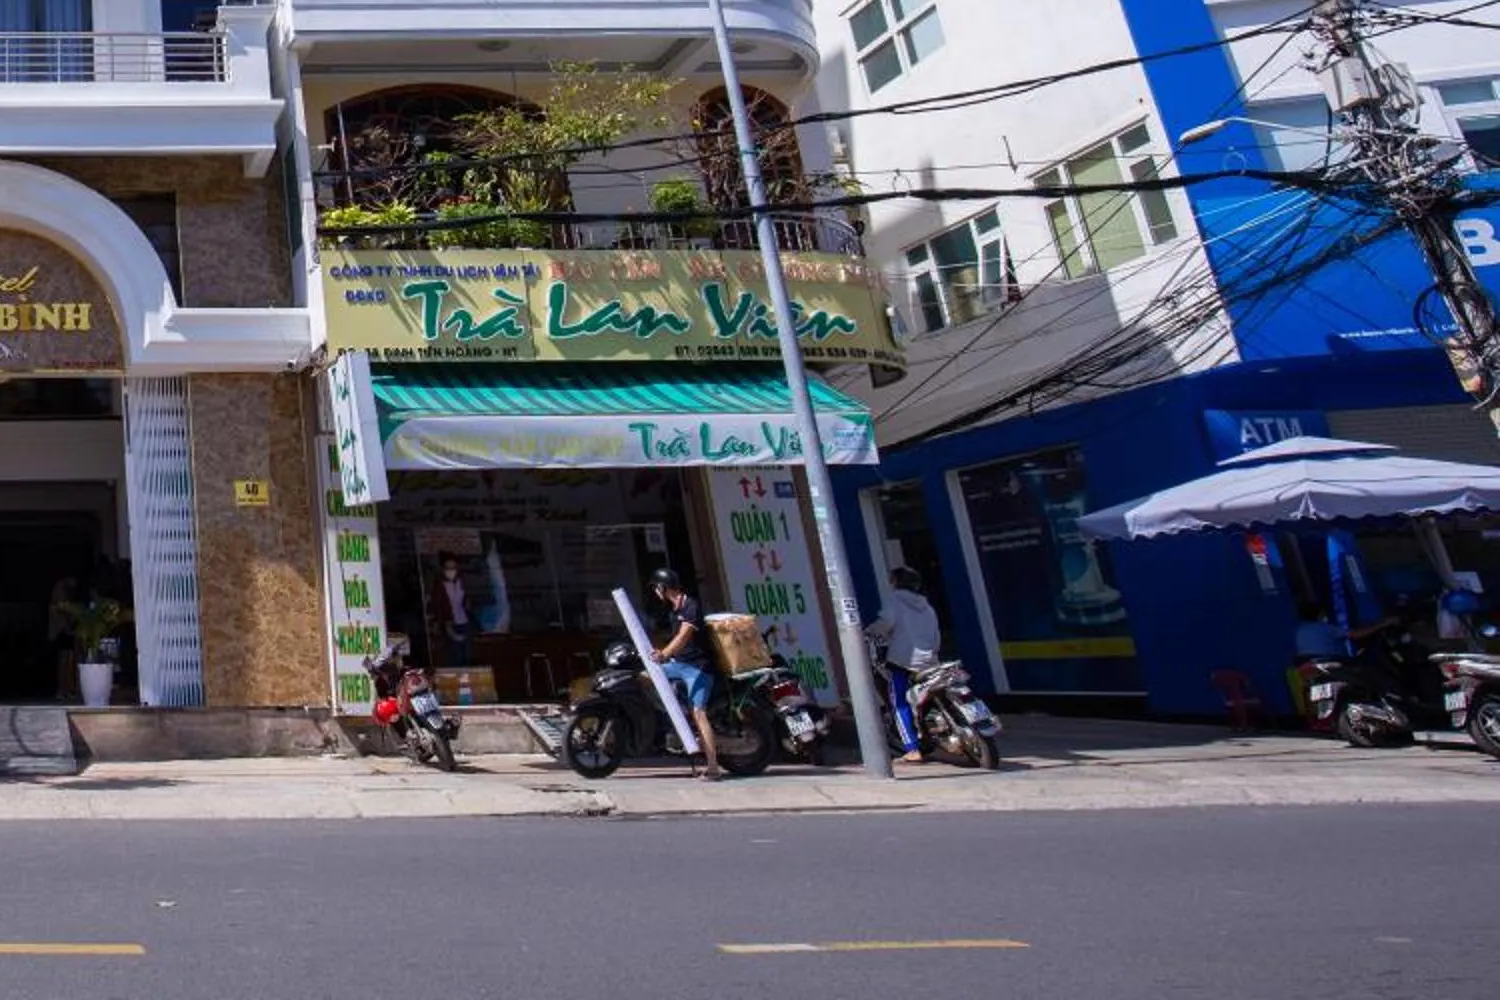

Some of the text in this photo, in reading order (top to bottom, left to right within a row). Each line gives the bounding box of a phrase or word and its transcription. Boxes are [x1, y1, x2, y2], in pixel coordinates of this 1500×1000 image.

[403, 280, 524, 341] Trà
[547, 280, 690, 340] Lan
[628, 422, 692, 460] Trà
[1241, 417, 1304, 444] ATM
[731, 503, 791, 547] QUẬN 1
[743, 576, 806, 621] QUẬN 5
